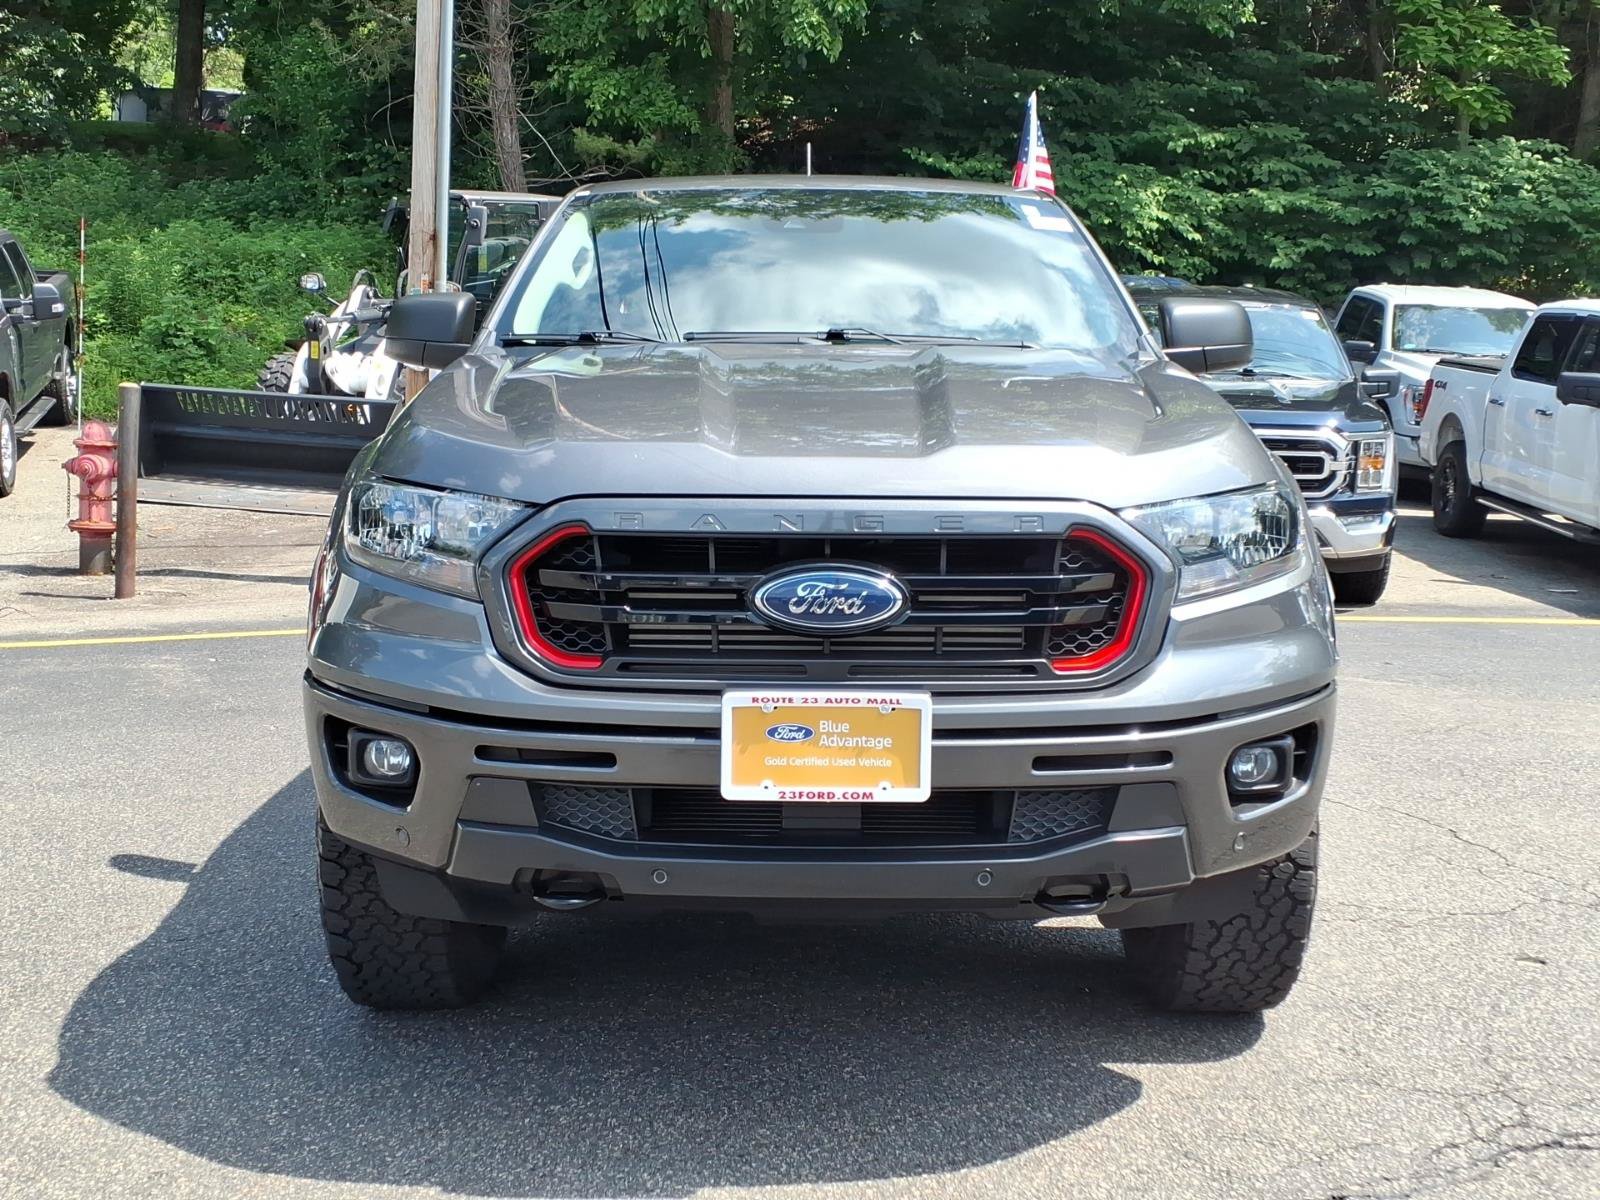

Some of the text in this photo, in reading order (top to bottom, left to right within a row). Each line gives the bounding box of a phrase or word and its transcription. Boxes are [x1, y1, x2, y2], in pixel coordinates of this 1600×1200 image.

[613, 511, 1043, 531] RANGER
[788, 581, 868, 614] Ford
[751, 696, 795, 704] ROUTE
[825, 697, 861, 705] AUTO
[774, 725, 806, 739] Ford
[819, 720, 850, 732] Blue
[819, 734, 892, 749] Advantage
[764, 756, 892, 767] Gold Certified Used Vehicle
[778, 791, 874, 800] 23FORD.COM
